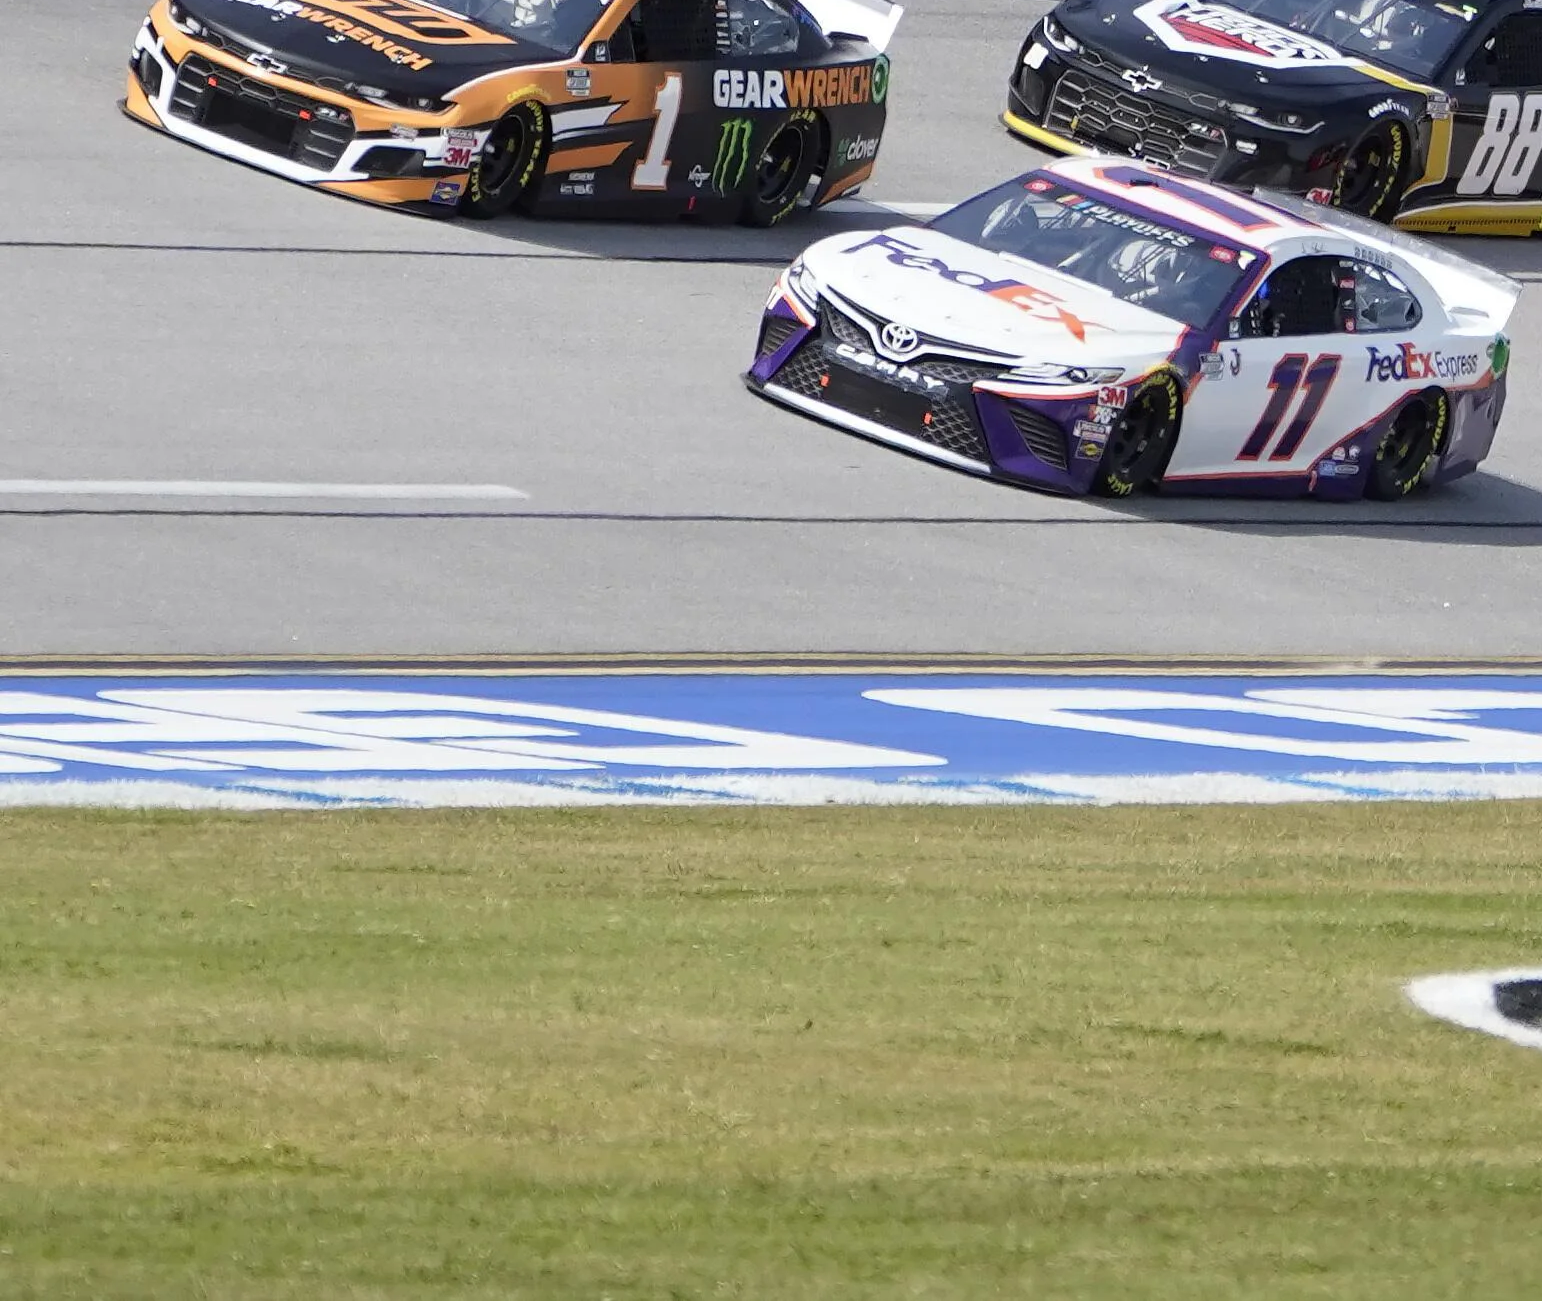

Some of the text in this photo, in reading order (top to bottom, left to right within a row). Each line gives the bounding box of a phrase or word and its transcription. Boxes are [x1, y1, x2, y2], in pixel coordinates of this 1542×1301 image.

[713, 65, 873, 109] GEARWRENCH
[631, 71, 683, 191] 1
[846, 135, 879, 161] clover
[443, 148, 473, 167] 3M
[840, 233, 1116, 345] FedEx
[835, 343, 947, 389] CAMRY
[1365, 342, 1478, 383] FedEx Express
[1099, 386, 1126, 407] 3M
[1234, 352, 1343, 461] 11
